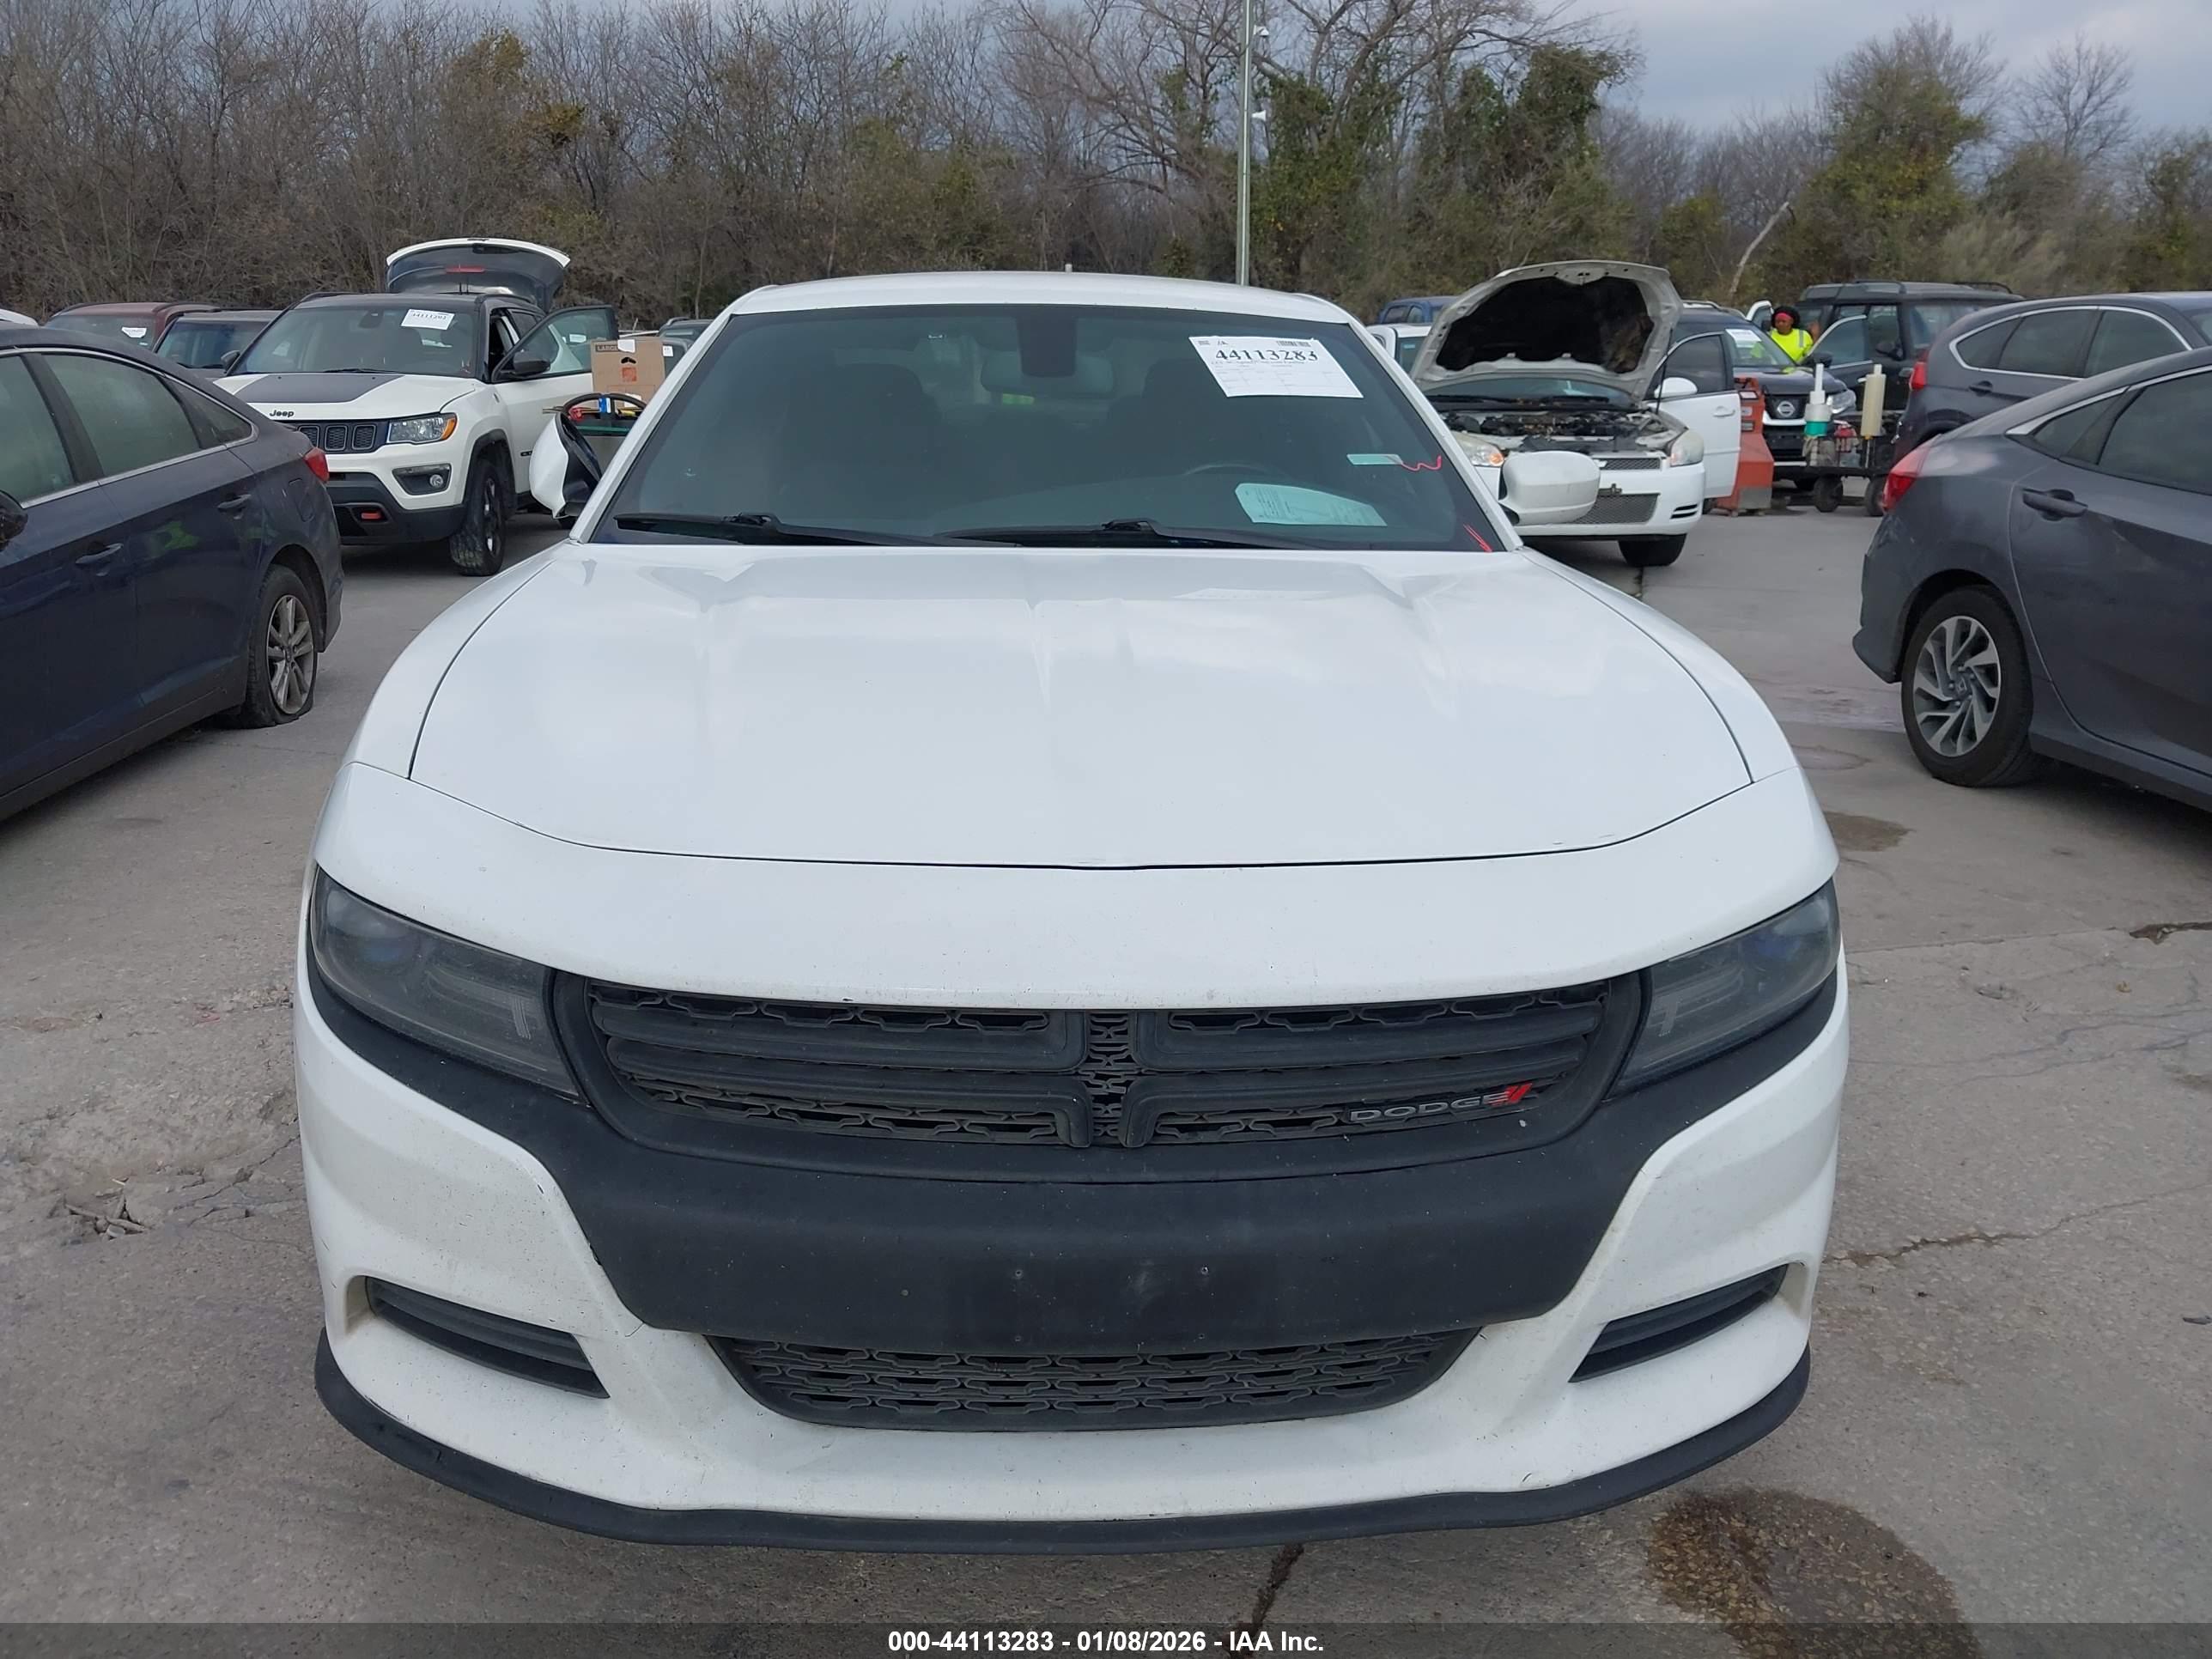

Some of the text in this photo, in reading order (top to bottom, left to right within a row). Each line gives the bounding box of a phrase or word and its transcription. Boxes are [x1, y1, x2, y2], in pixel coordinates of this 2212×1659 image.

[1215, 349, 1318, 362] 44113283
[269, 409, 295, 418] Jeep
[1351, 1091, 1510, 1121] DODGE
